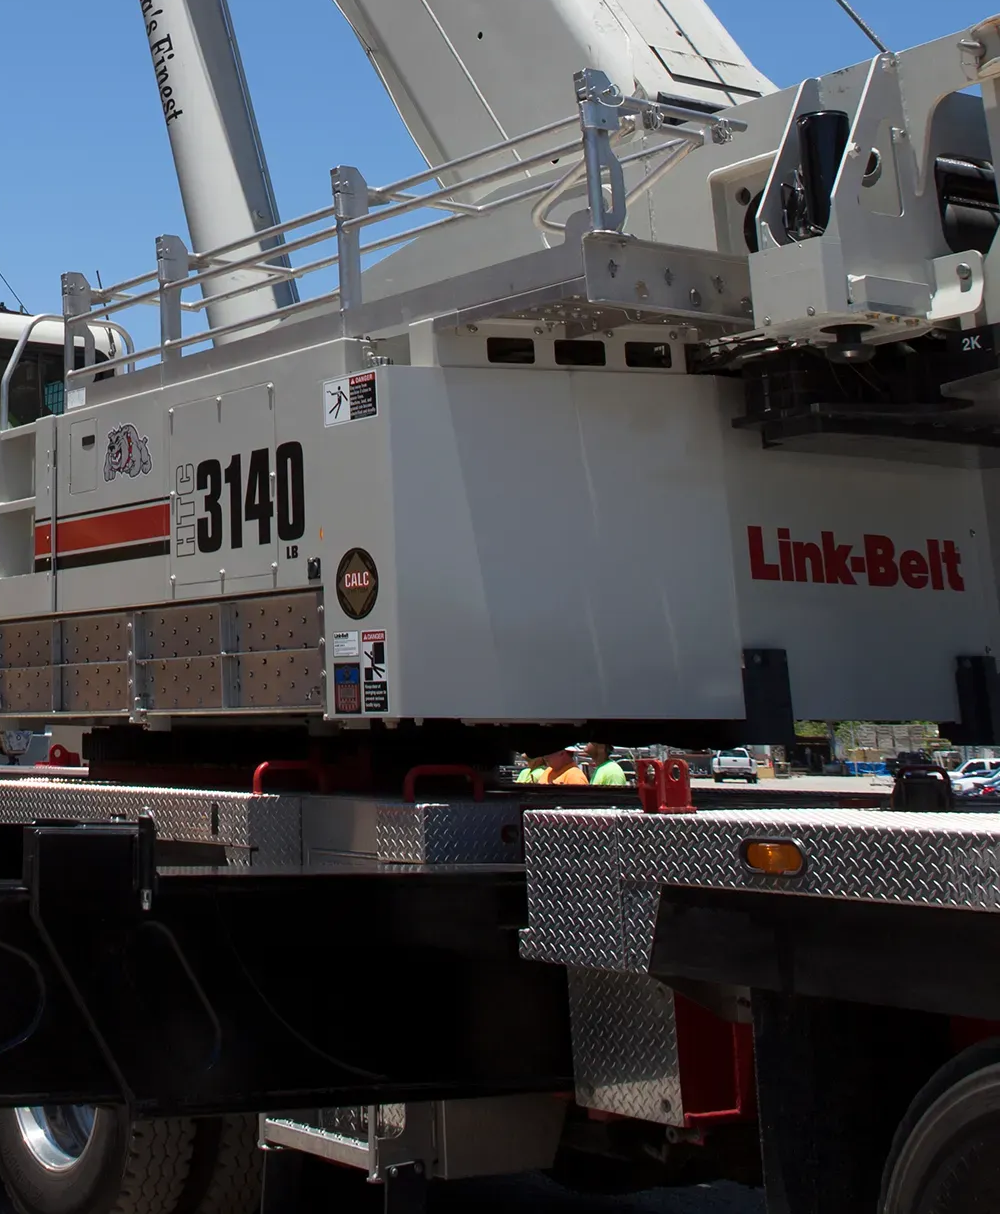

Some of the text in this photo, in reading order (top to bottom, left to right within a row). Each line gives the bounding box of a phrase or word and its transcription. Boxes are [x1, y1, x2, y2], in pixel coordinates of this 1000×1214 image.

[150, 33, 183, 126] Finest
[961, 335, 981, 351] 2K
[176, 463, 195, 558] HTC
[197, 441, 305, 553] 3140
[286, 545, 299, 559] LB
[344, 571, 370, 588] CALC
[747, 526, 965, 591] Link-Belt
